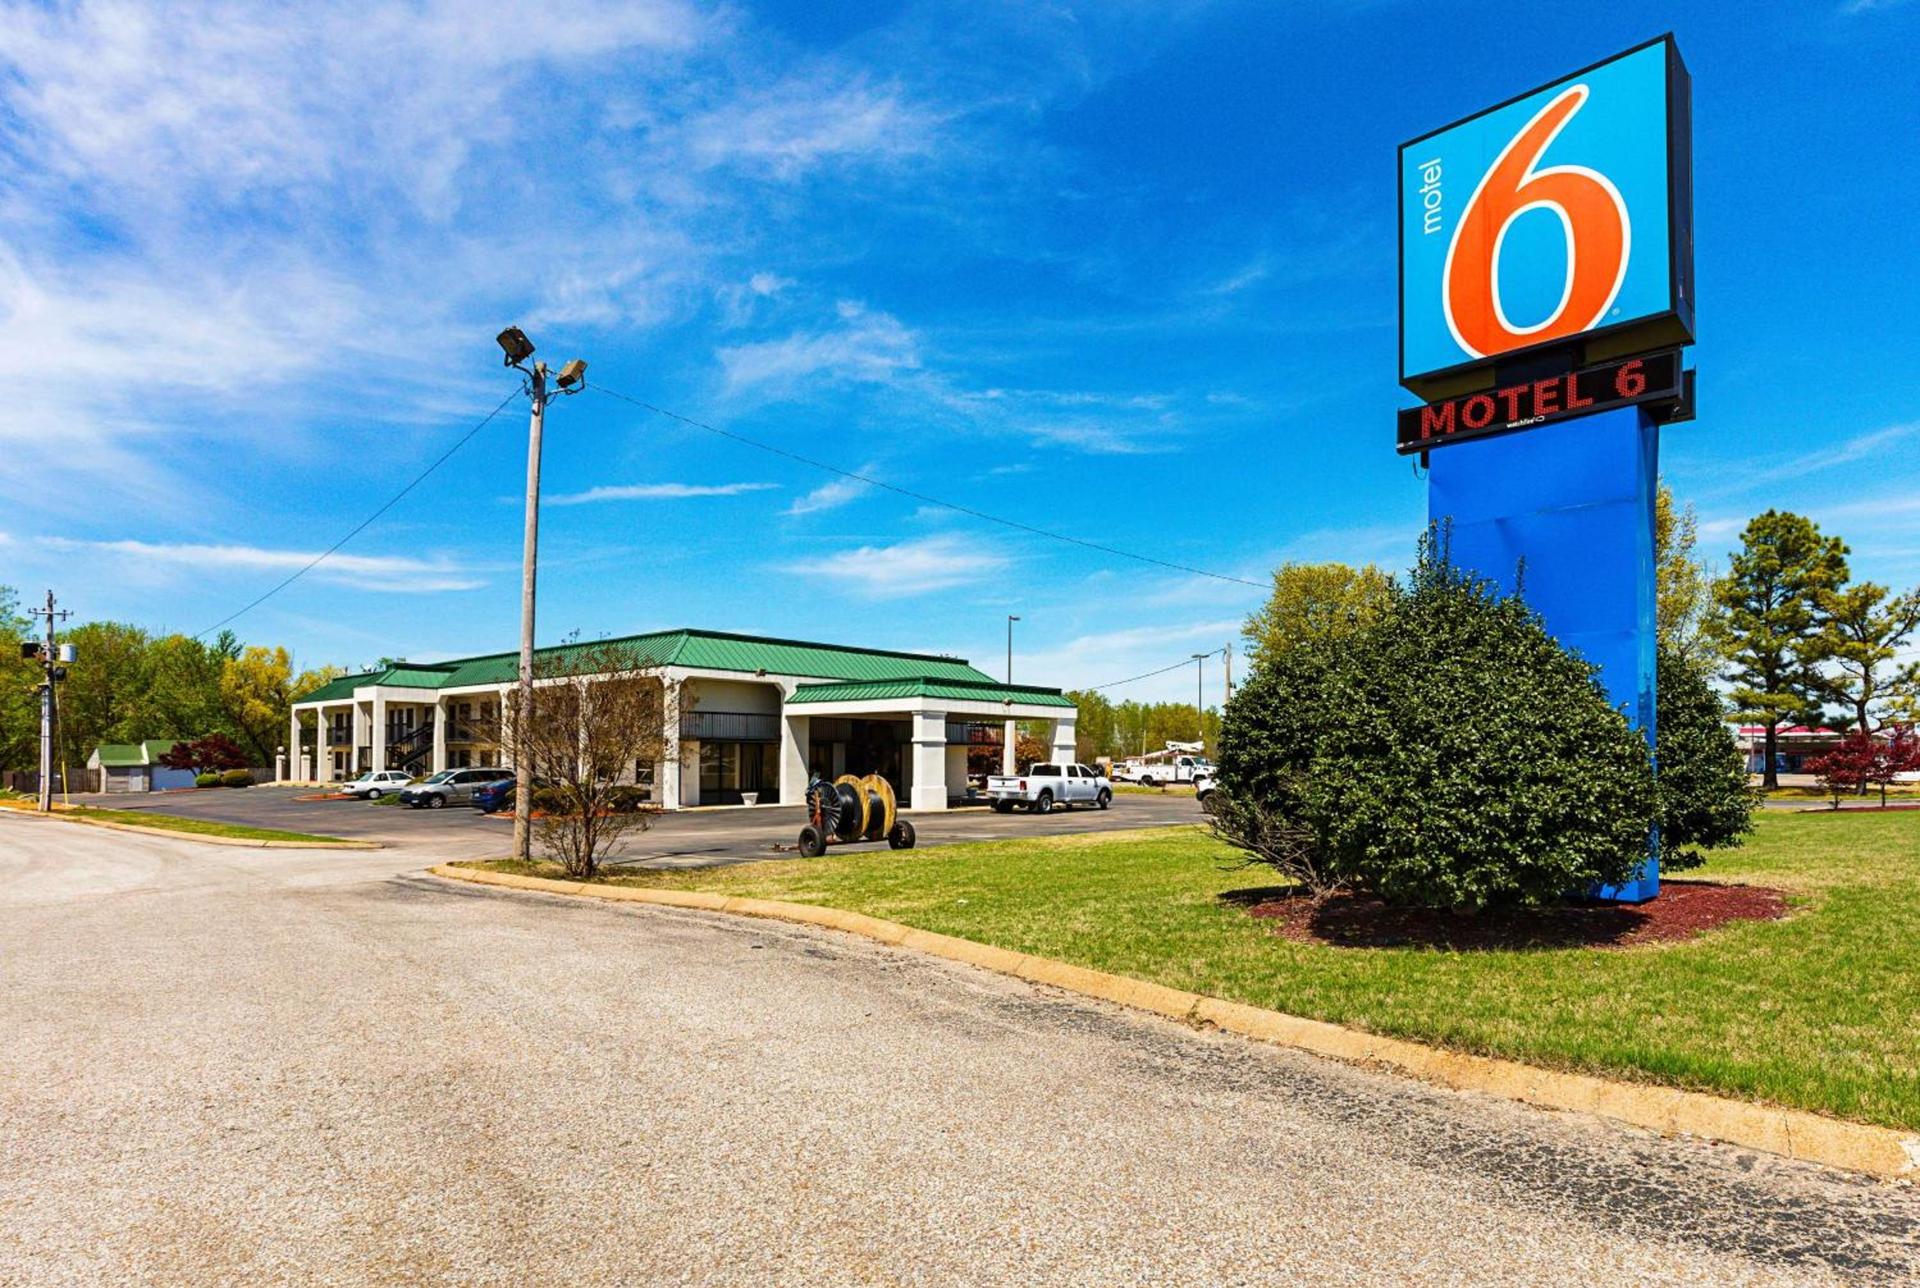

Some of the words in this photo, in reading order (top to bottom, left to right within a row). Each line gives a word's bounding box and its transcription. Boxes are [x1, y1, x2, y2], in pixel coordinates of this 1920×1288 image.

[1418, 158, 1442, 235] motel
[1442, 83, 1632, 360] 6
[1420, 372, 1593, 440] MOTEL
[1615, 359, 1646, 398] 6
